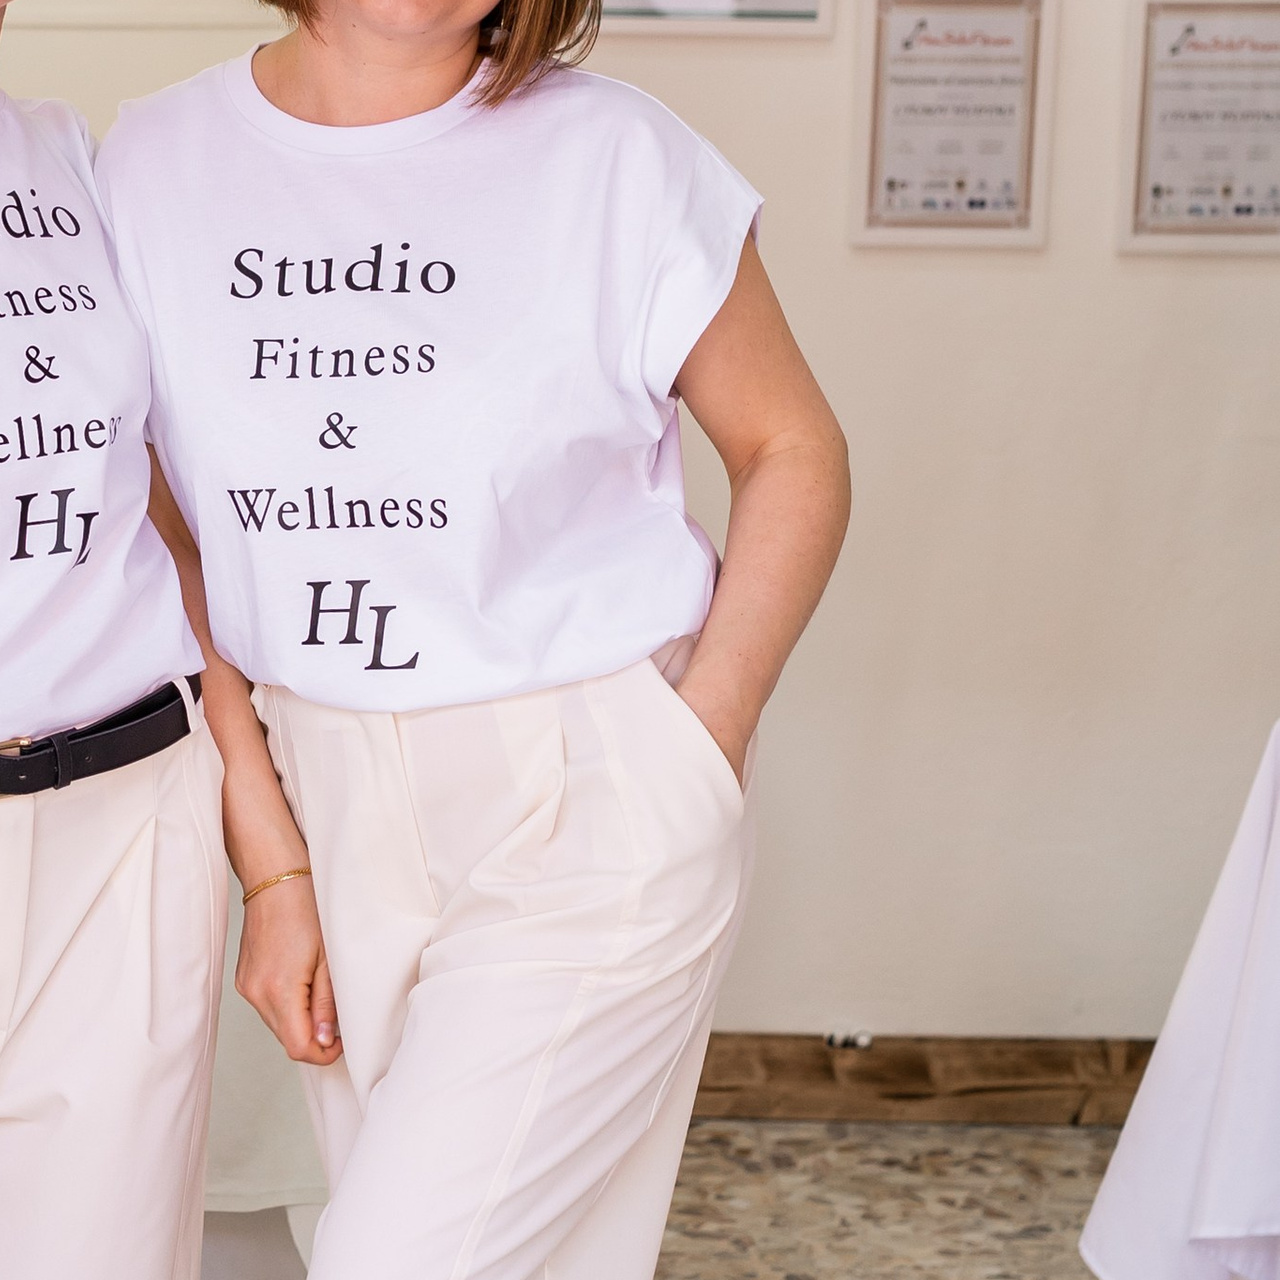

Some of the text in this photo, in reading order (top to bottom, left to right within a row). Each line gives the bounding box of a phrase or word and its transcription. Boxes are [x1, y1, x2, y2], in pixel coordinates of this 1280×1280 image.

[230, 242, 456, 299] Studio
[22, 345, 60, 384] &
[249, 337, 436, 380] Fitness
[318, 412, 358, 450] &
[226, 485, 449, 533] Wellness
[301, 579, 420, 671] HL
